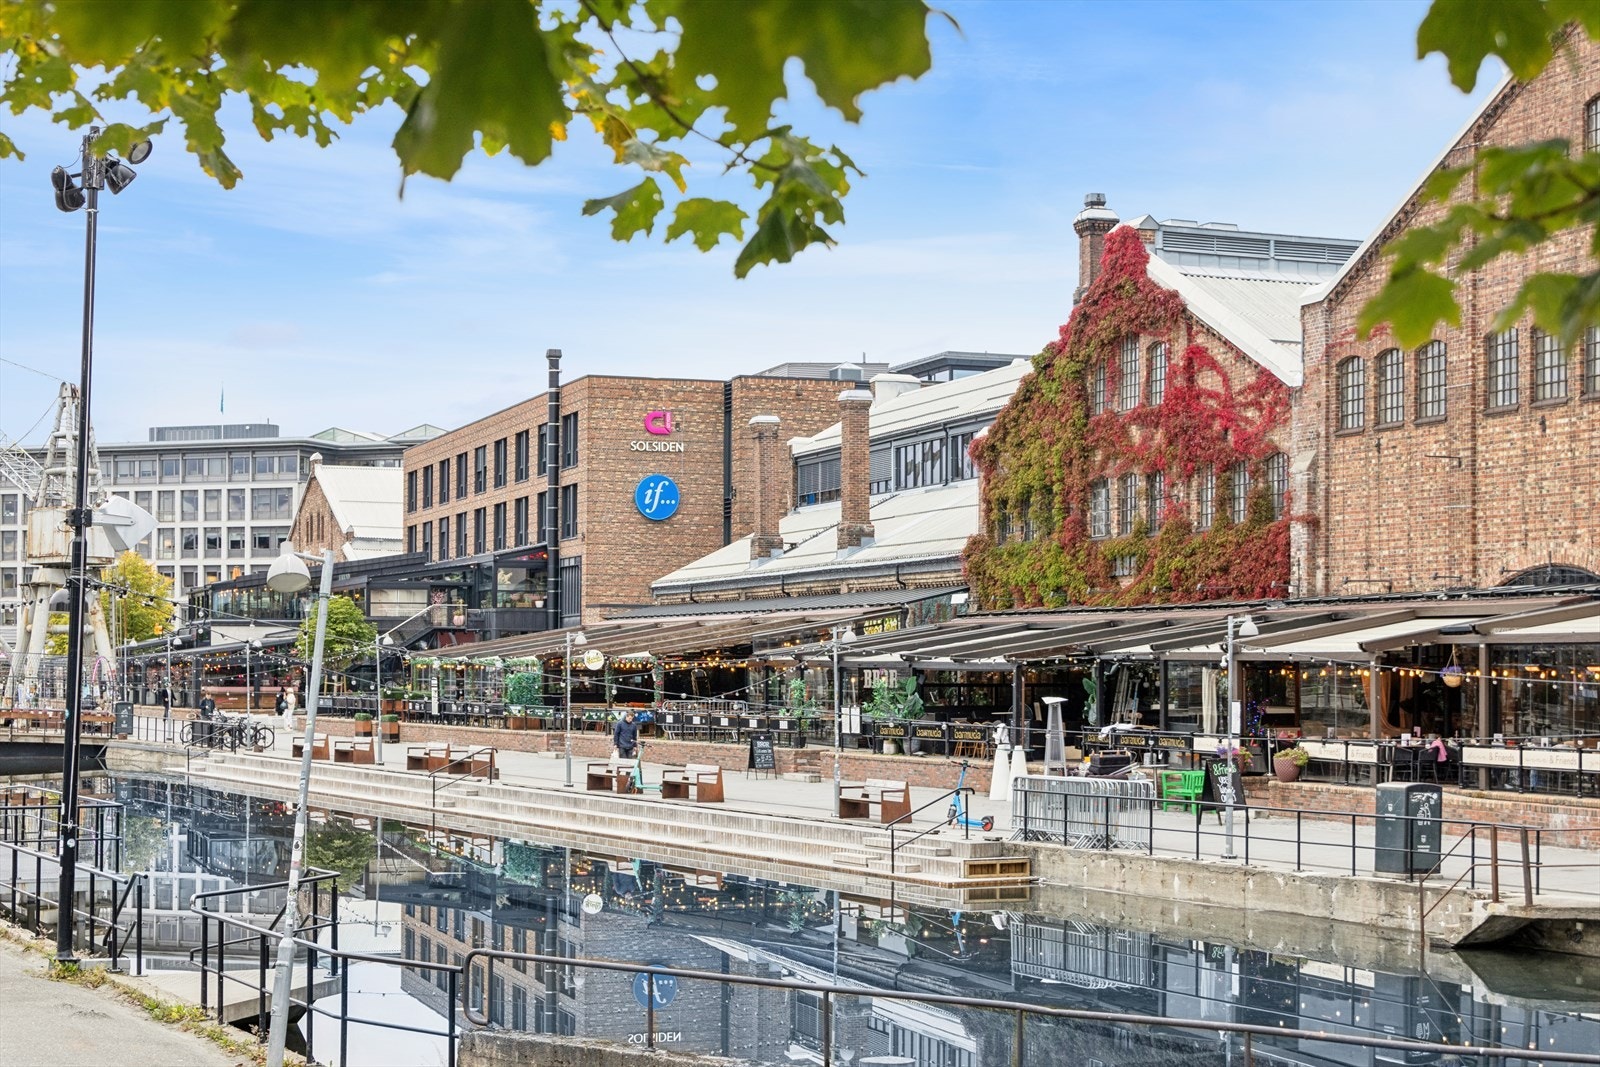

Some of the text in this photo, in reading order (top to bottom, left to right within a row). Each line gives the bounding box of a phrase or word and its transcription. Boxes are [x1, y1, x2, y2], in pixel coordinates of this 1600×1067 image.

[630, 441, 684, 453] SOLSIDEN
[1494, 752, 1515, 763] Friends
[1555, 755, 1577, 766] Friends
